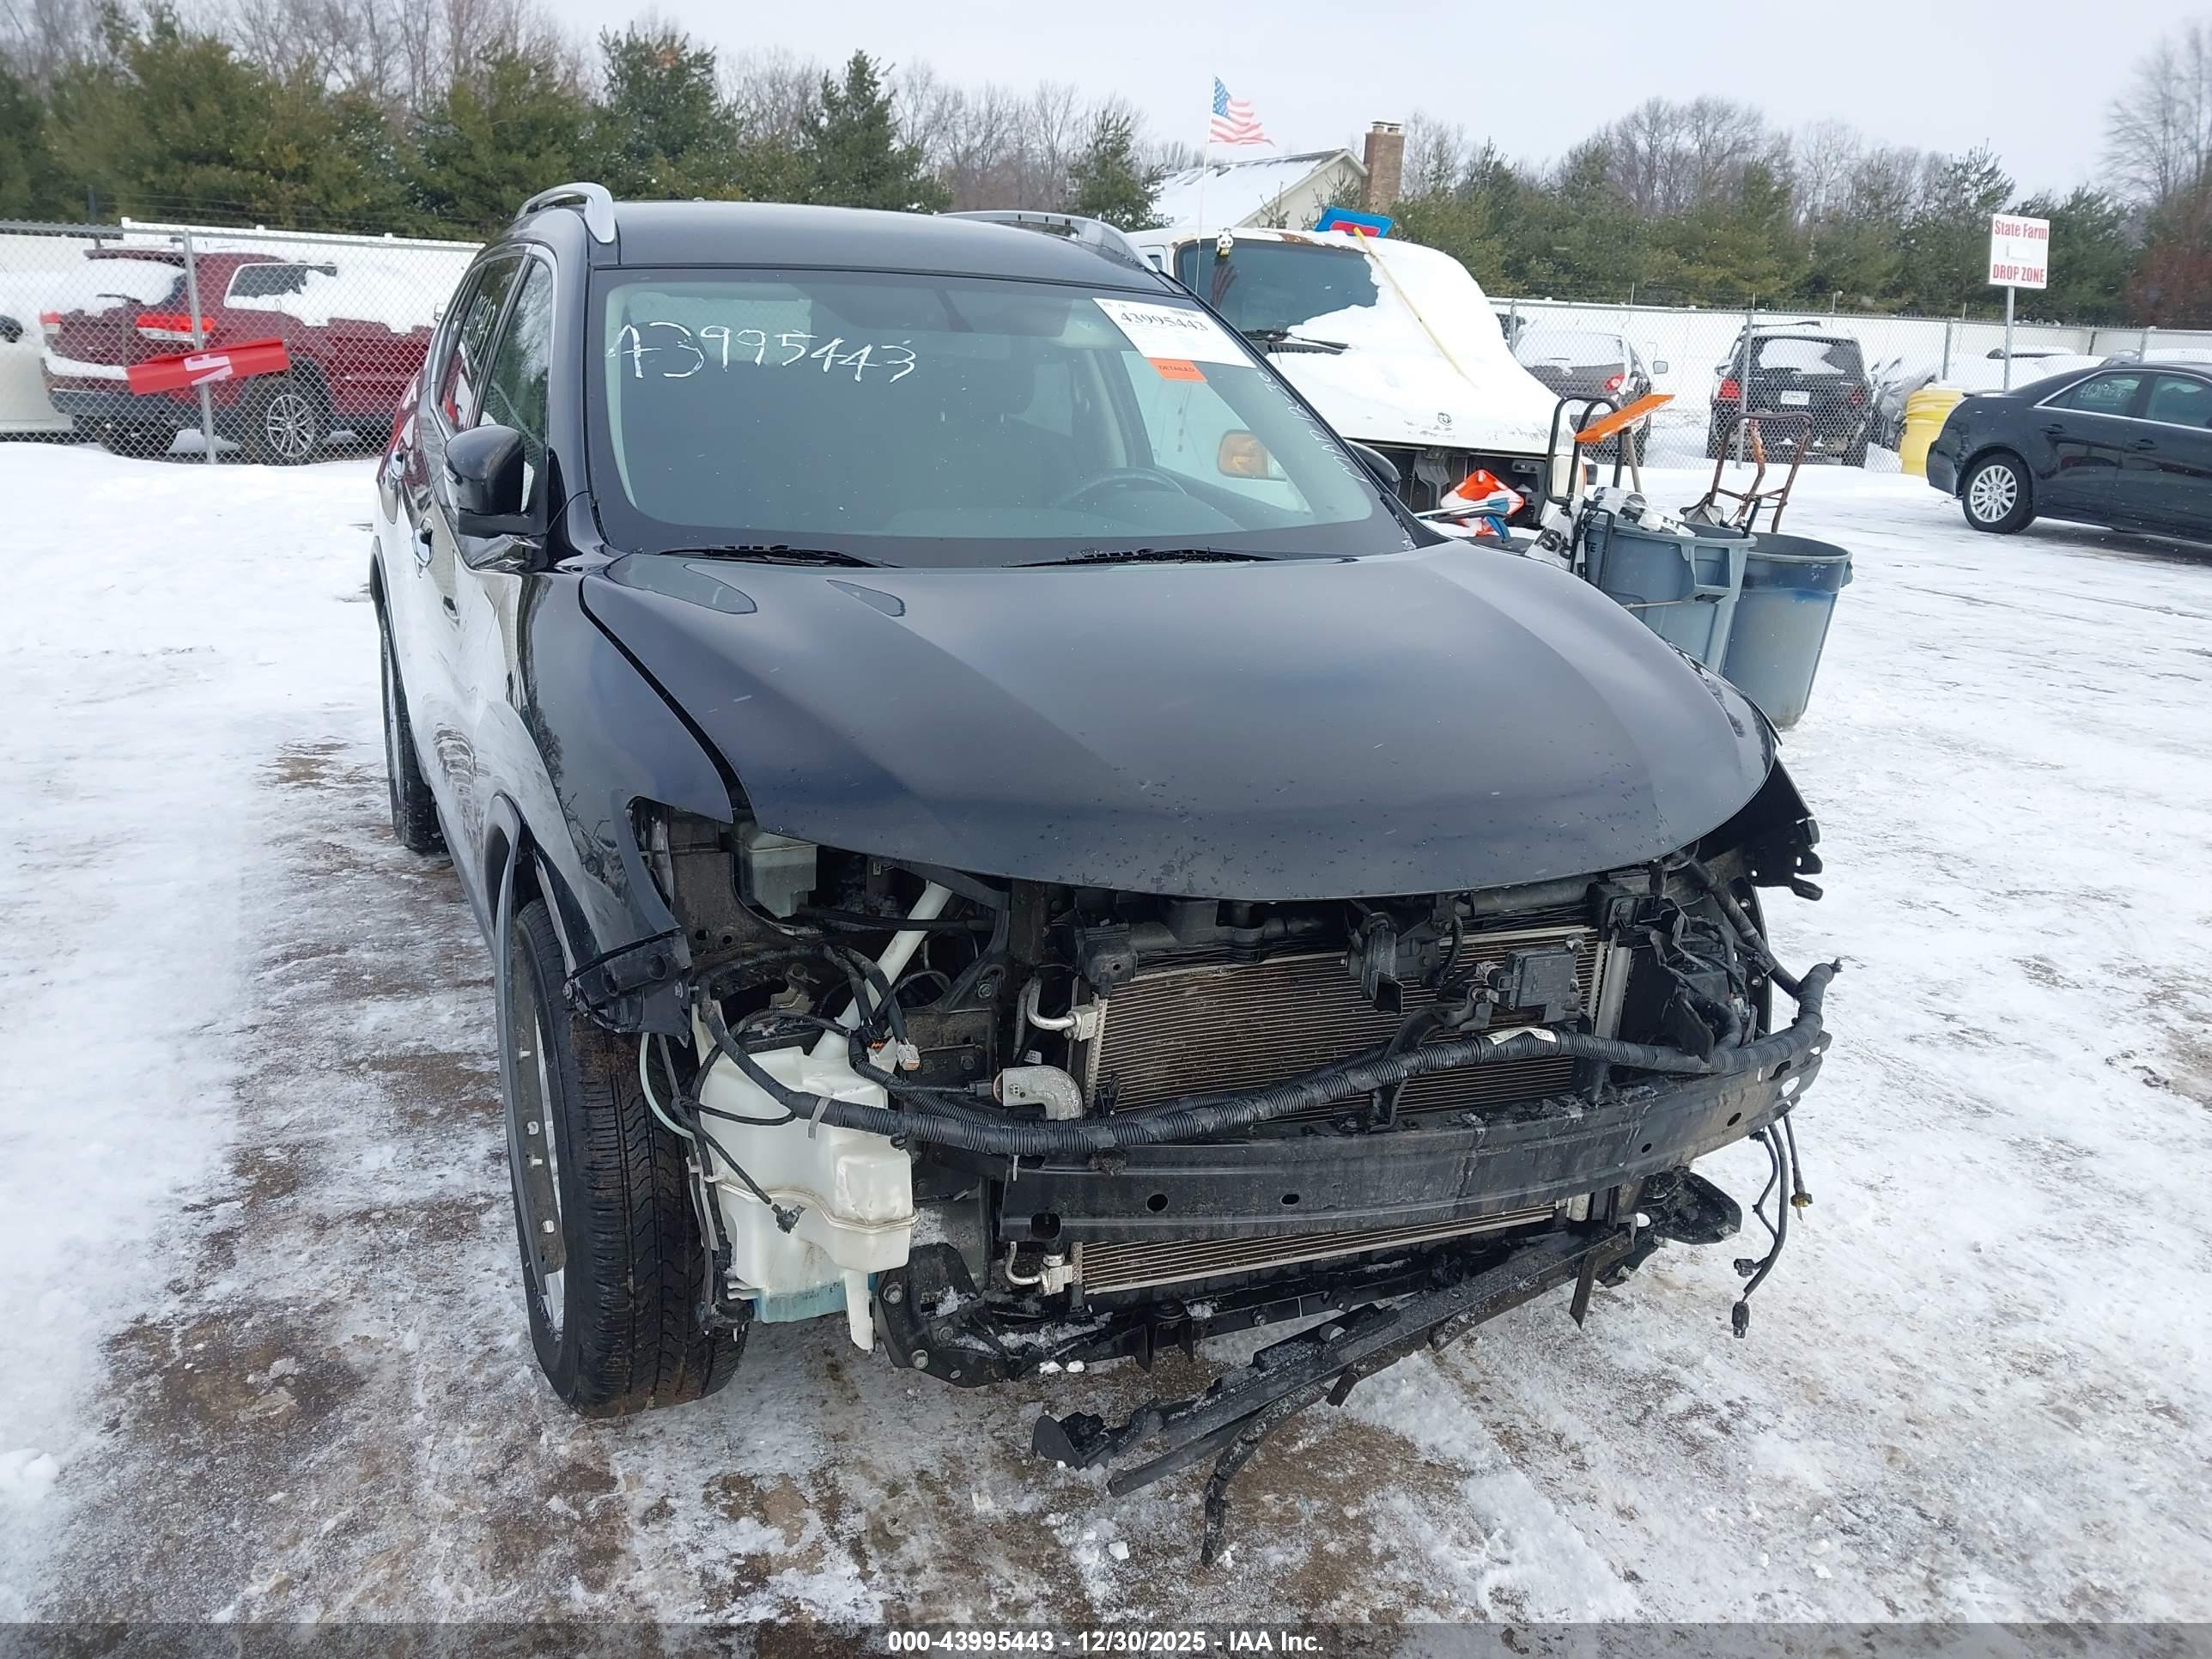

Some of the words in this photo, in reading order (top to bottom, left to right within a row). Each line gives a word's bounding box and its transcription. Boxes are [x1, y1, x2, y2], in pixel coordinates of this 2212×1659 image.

[1995, 220, 2021, 237] State
[2023, 223, 2048, 240] Farm
[1993, 264, 2019, 280] DROP
[2021, 267, 2045, 283] ZONE
[1121, 312, 1209, 331] 43995443
[605, 320, 917, 384] 43995443
